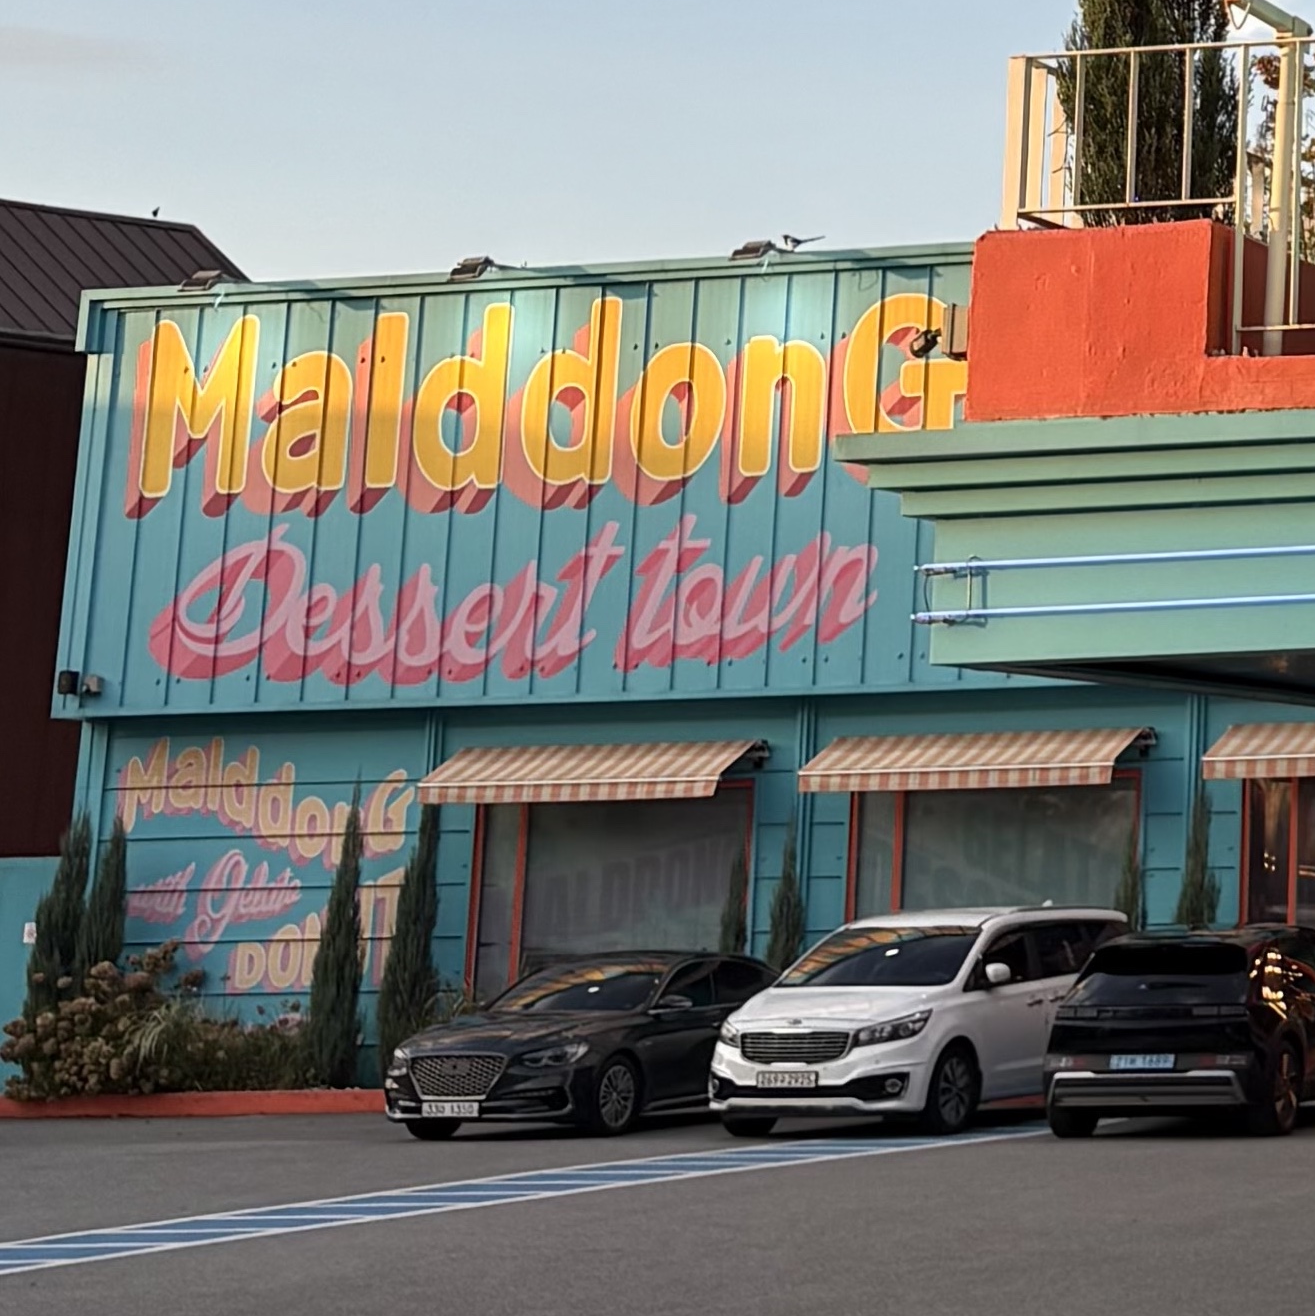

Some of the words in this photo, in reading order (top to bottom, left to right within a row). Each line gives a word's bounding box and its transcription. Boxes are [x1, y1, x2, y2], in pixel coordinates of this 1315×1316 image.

[126, 293, 967, 517] MalddonG
[150, 521, 624, 684] Dessert
[613, 513, 881, 673] town
